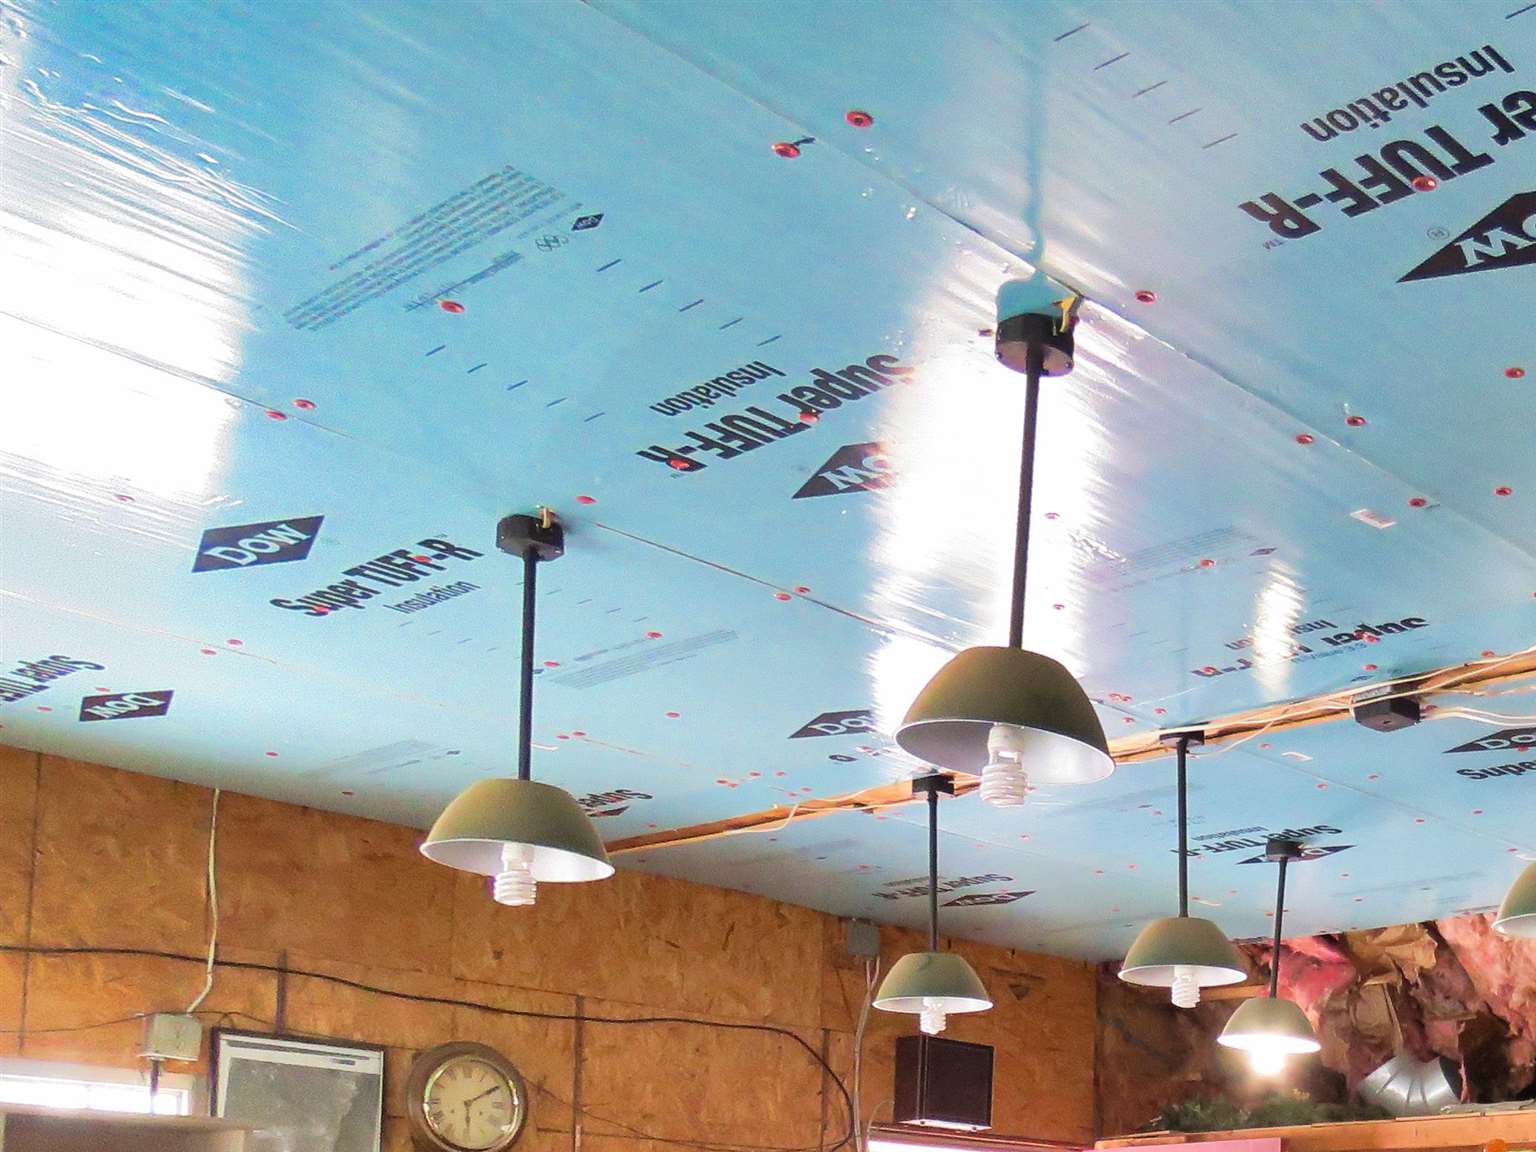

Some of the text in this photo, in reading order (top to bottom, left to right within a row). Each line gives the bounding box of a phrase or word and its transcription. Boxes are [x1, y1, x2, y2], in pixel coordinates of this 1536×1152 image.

[1300, 44, 1515, 142] Insulation
[1238, 125, 1495, 238] TUFF-R
[635, 354, 914, 472] Super TUFF-R
[650, 361, 786, 416] Insulation
[203, 523, 312, 566] DOW
[270, 538, 485, 617] Super TUFF-R
[384, 580, 481, 614] Insulation
[8, 655, 105, 682] Super
[84, 693, 165, 719] DOW
